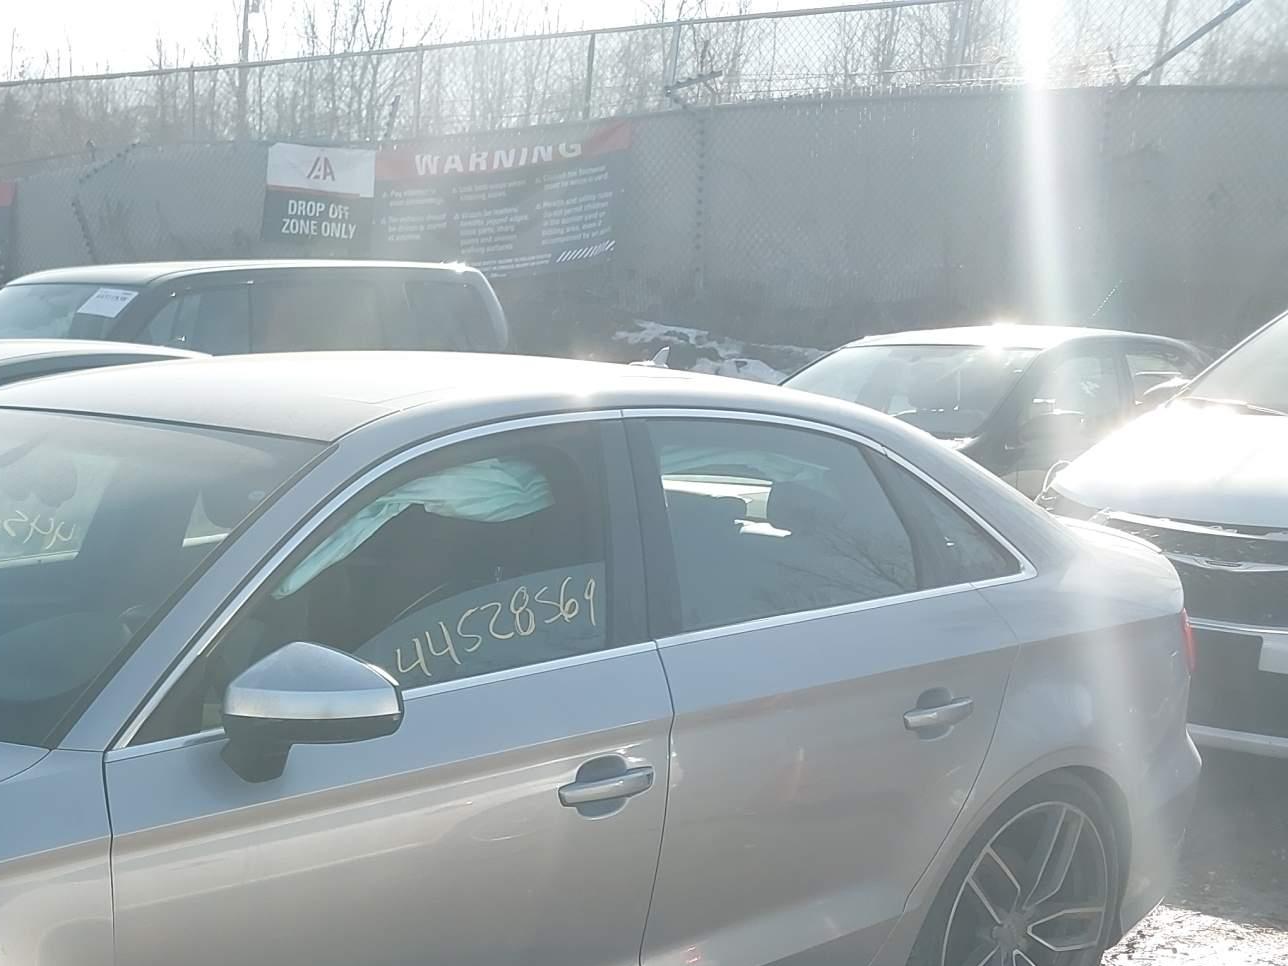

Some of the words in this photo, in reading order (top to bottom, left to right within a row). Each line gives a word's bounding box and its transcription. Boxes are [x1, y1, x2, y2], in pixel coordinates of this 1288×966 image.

[415, 143, 582, 176] WARNING
[288, 200, 326, 217] DROP
[328, 203, 351, 221] OFF
[281, 218, 318, 236] ZONE
[321, 221, 357, 240] ONLY
[397, 576, 597, 677] 44528569
